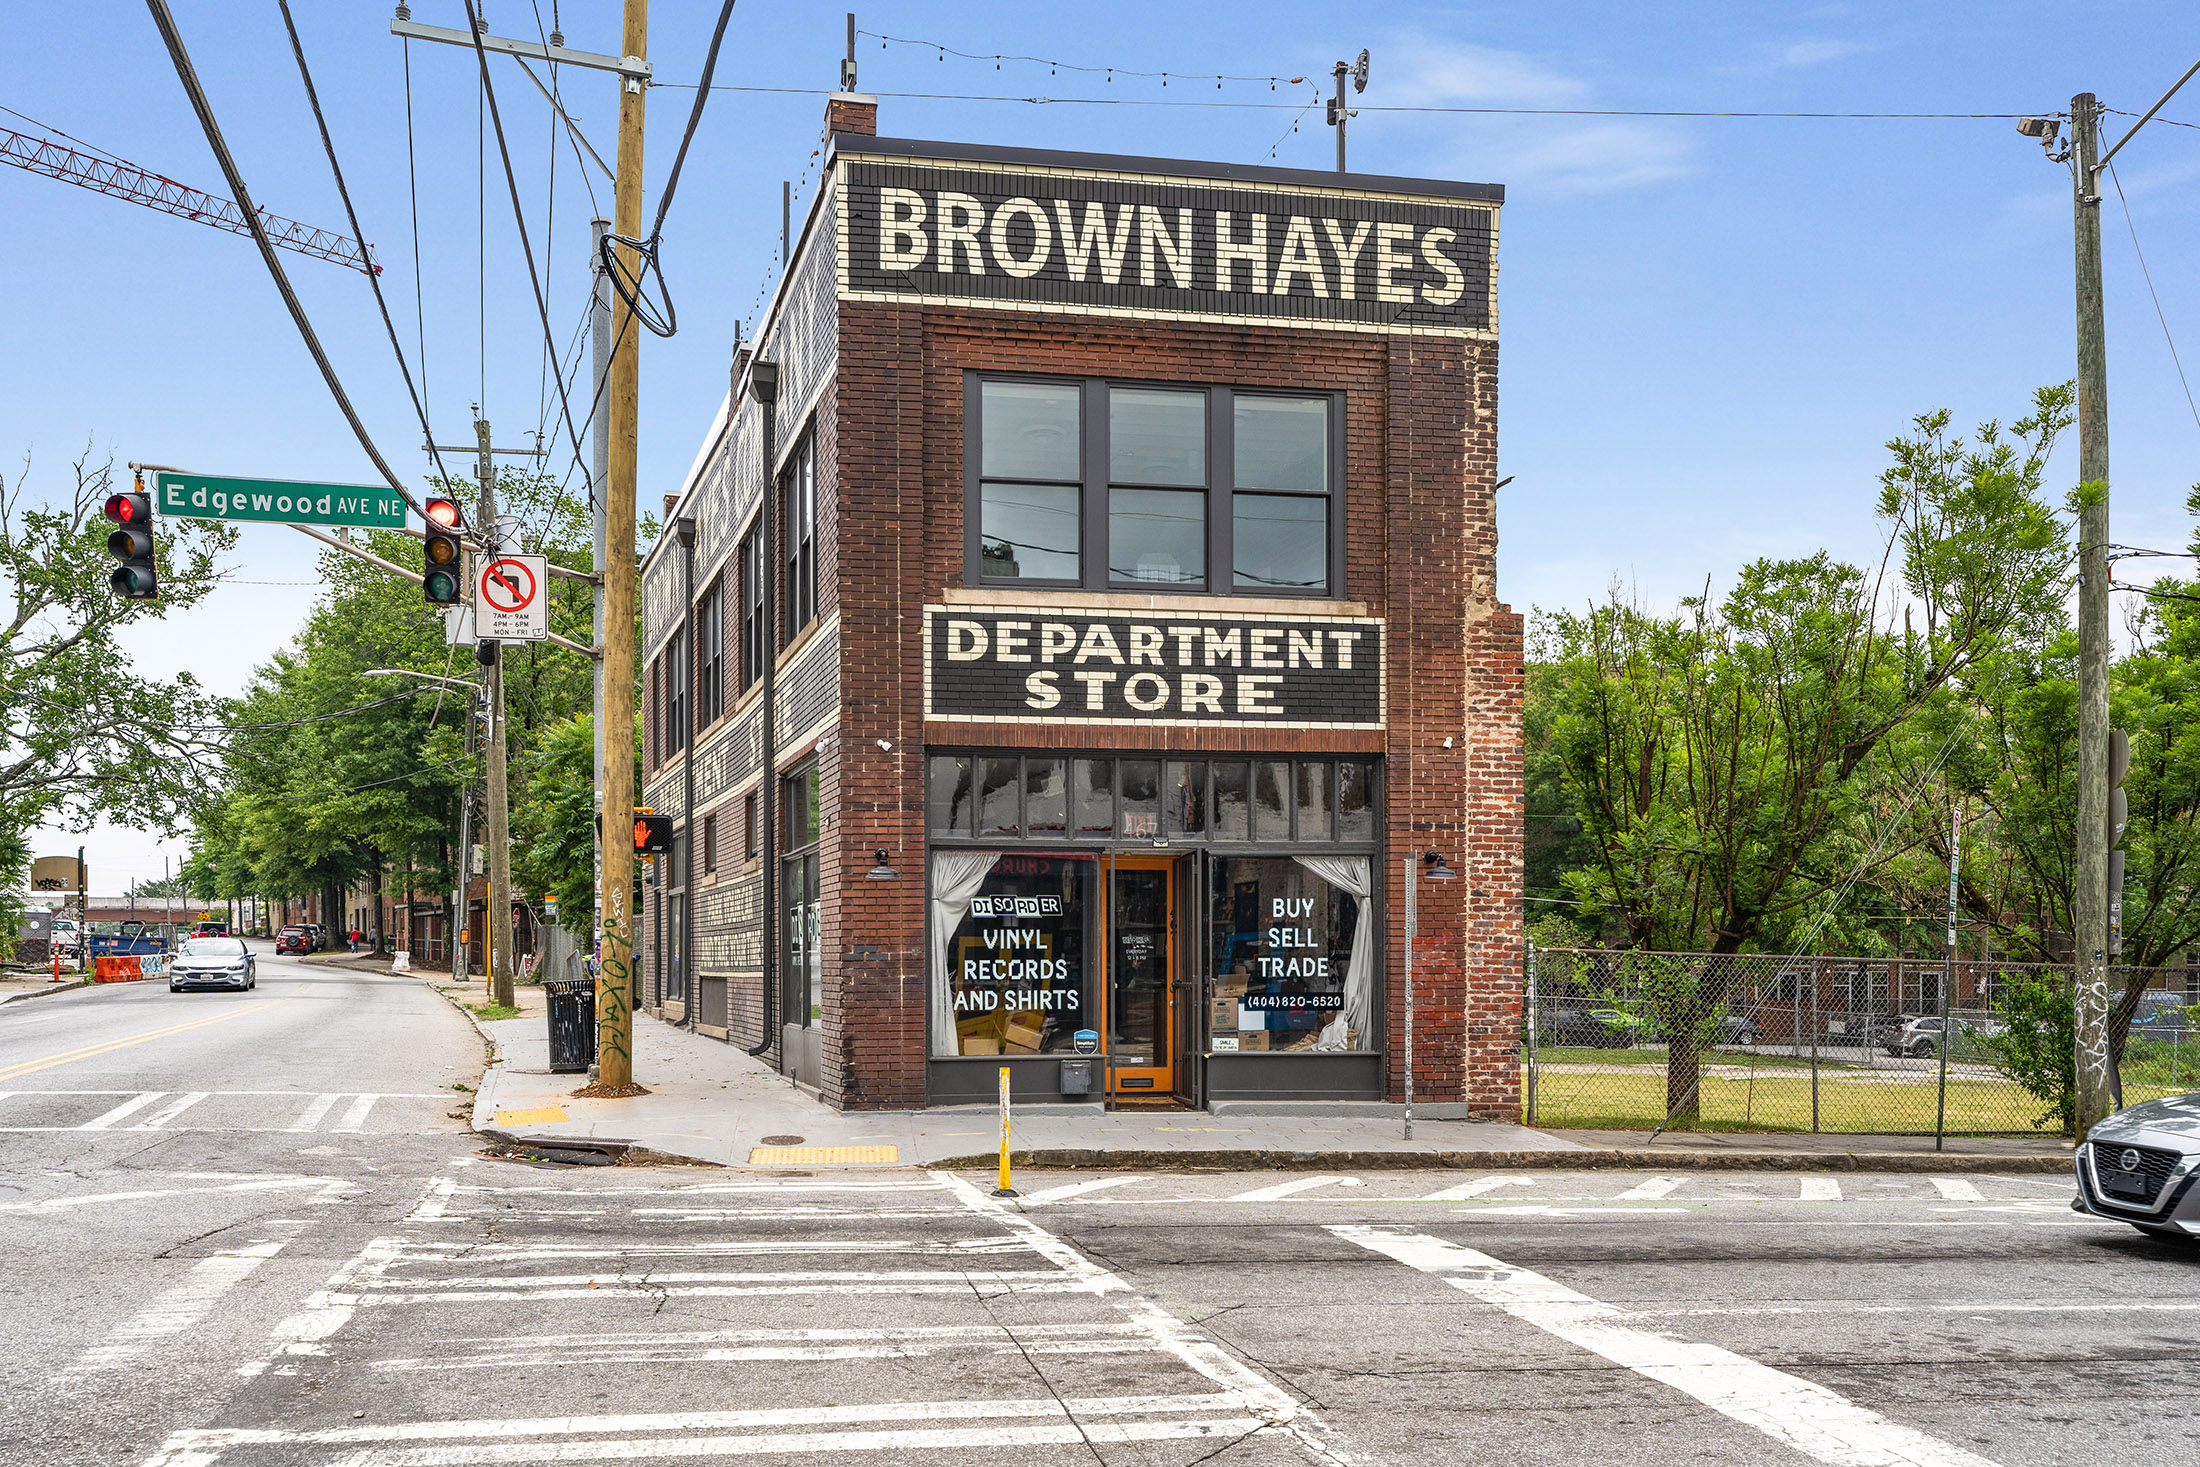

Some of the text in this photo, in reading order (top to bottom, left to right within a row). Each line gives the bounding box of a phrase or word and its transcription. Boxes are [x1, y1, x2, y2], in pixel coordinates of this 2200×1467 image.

[878, 187, 1467, 307] BROWN HAYES
[166, 483, 401, 516] Edgewood AVE NE
[946, 620, 1362, 670] DEPARTMENT
[1024, 670, 1284, 714] STORE
[748, 680, 793, 769] STRE
[1123, 822, 1158, 840] 467
[973, 897, 1060, 915] DISORDER
[1272, 898, 1314, 918] BUY
[983, 929, 1048, 950] VINYL
[1268, 928, 1318, 948] SELL
[964, 959, 1068, 980] RECORDS
[1257, 957, 1329, 977] TRADE
[953, 989, 1079, 1011] AND SHIRTS
[1247, 996, 1341, 1008] (404)820-6520
